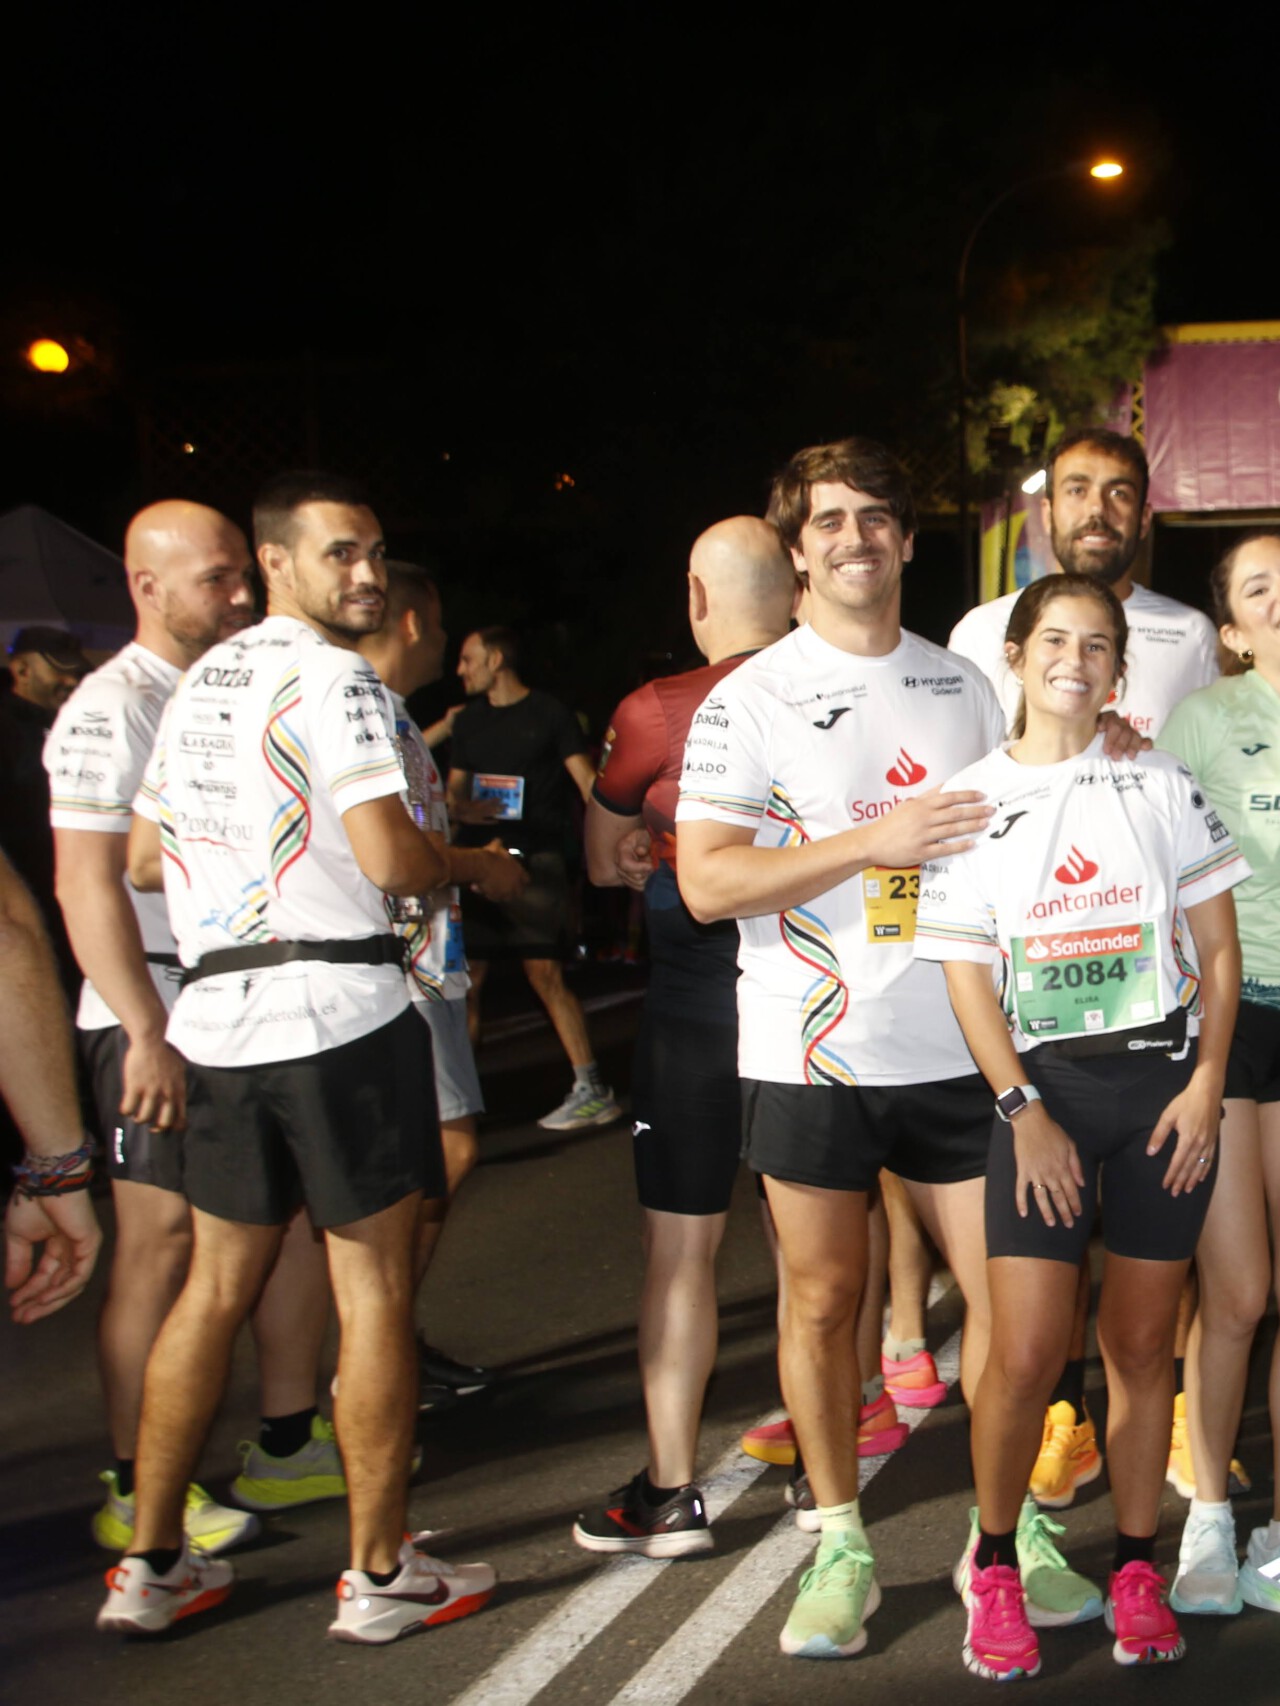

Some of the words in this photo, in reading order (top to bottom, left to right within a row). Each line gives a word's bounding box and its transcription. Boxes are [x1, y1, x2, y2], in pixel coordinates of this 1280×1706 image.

[888, 875, 920, 900] 23
[1050, 931, 1141, 957] Santander
[1042, 956, 1129, 992] 2084
